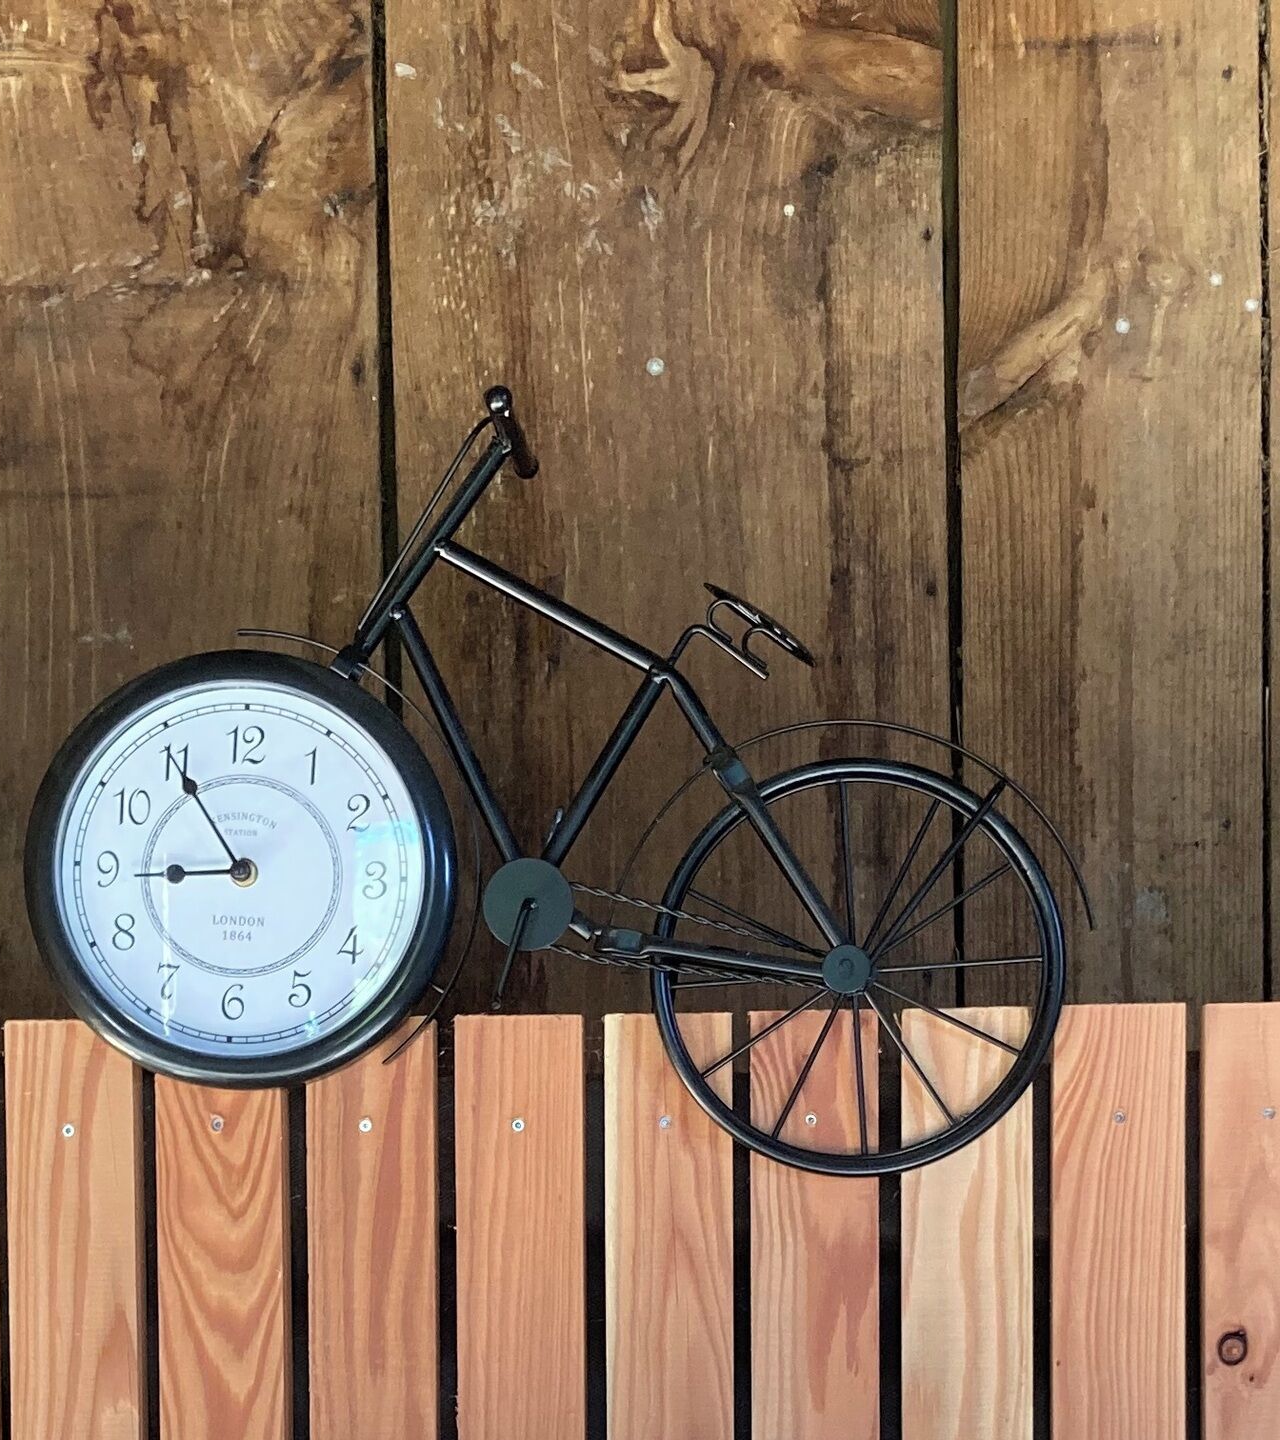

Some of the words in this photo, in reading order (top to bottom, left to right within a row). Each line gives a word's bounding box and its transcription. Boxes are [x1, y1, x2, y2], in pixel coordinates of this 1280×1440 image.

[160, 743, 189, 782] 11
[226, 725, 266, 765] 12
[305, 746, 318, 785] 1
[113, 788, 151, 825] 10
[345, 794, 371, 833] 2
[223, 828, 258, 837] STATION
[97, 850, 119, 888] 9
[362, 861, 387, 899] 3
[111, 913, 136, 951] 8
[212, 915, 265, 928] LONDON
[221, 930, 253, 942] 1864
[337, 925, 364, 965] 4
[157, 962, 180, 1000] 7
[288, 970, 312, 1007] 5
[221, 984, 245, 1020] 6
